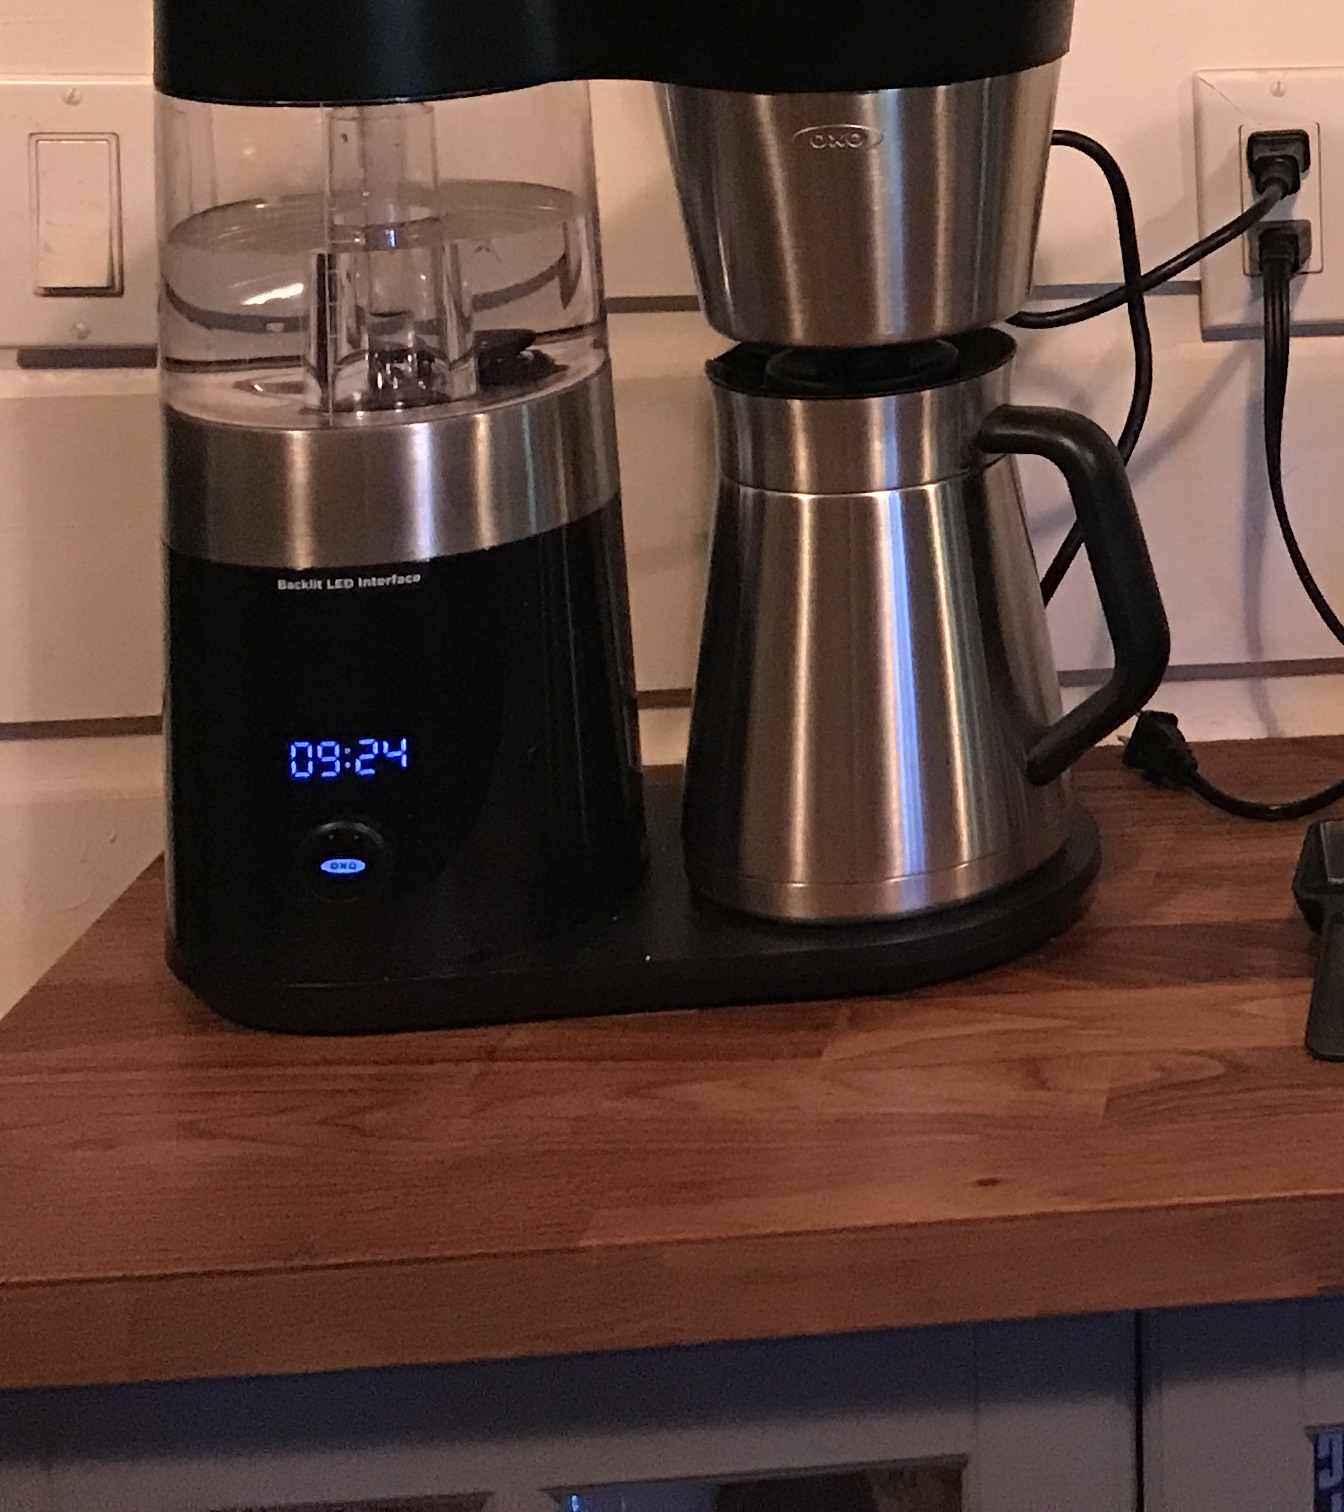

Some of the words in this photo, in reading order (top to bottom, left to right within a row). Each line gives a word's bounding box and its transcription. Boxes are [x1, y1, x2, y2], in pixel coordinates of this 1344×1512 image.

[277, 578, 323, 591] Backlit
[326, 578, 355, 590] LED
[358, 573, 422, 588] Interface
[289, 737, 408, 779] 09:24
